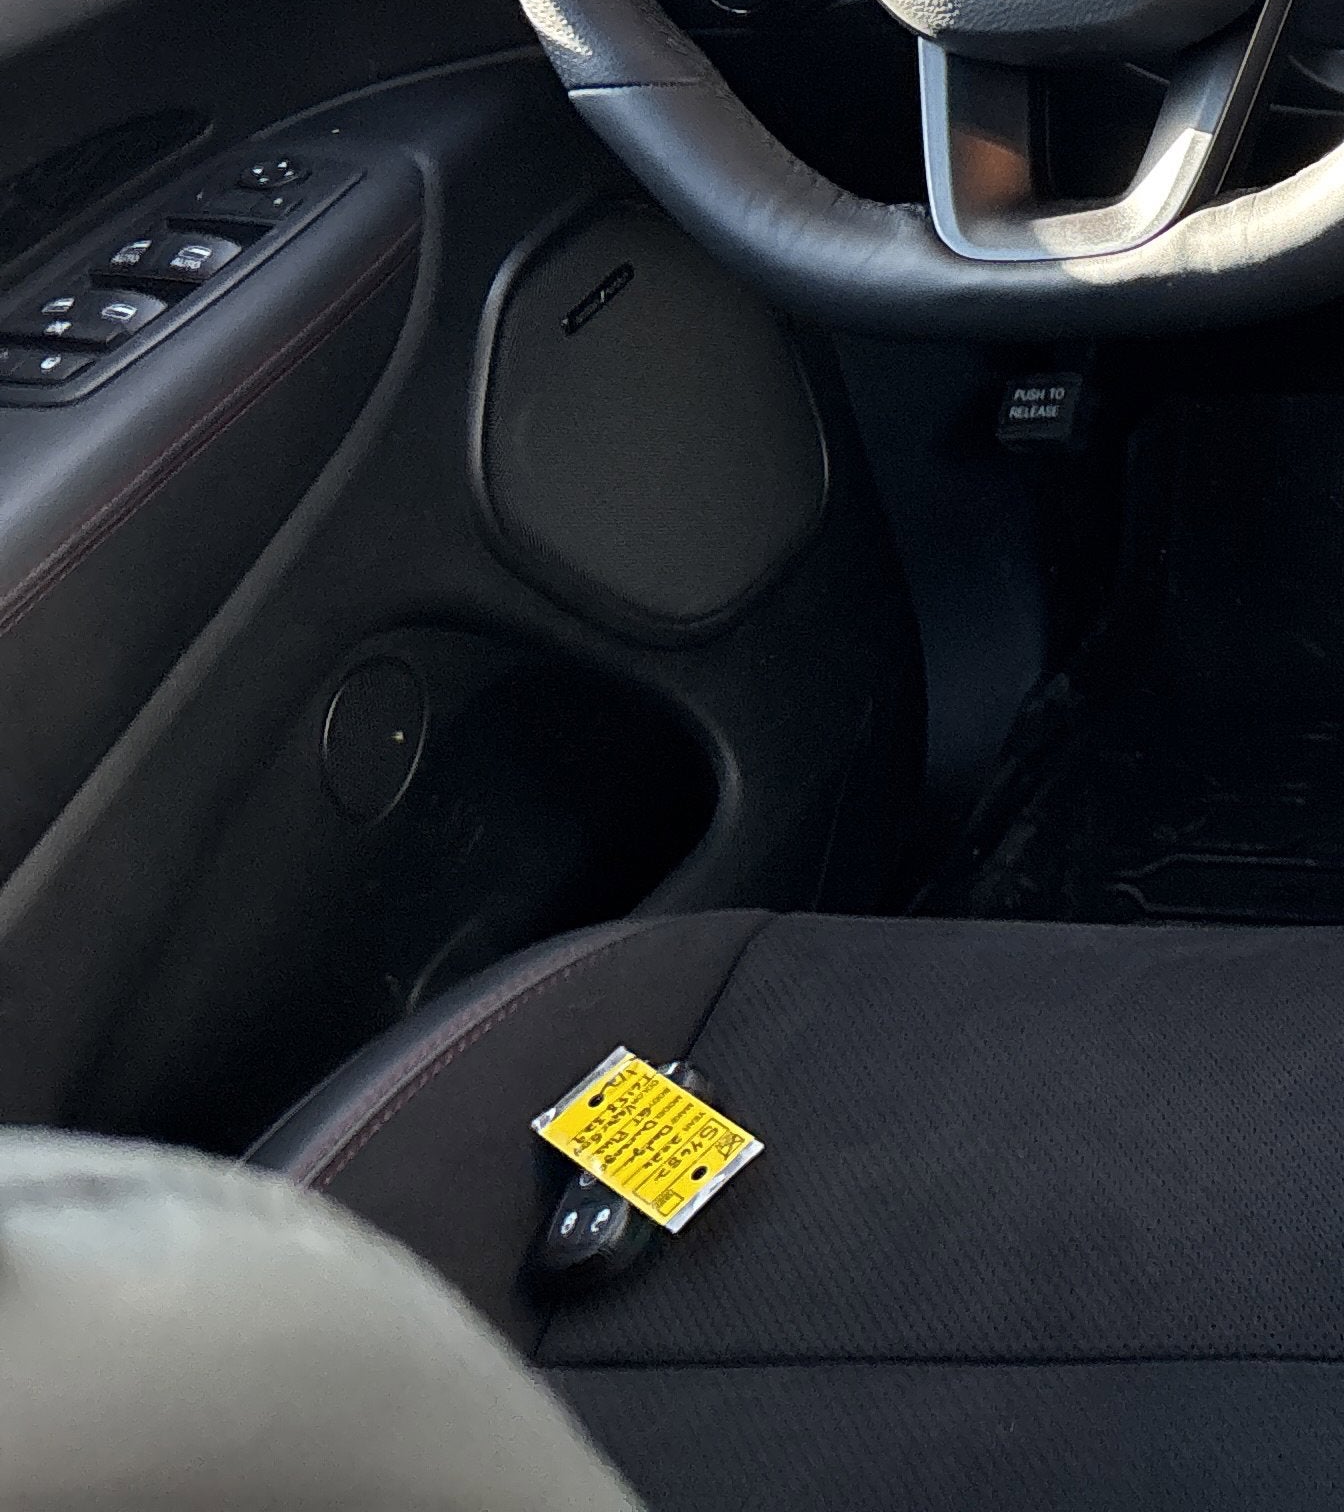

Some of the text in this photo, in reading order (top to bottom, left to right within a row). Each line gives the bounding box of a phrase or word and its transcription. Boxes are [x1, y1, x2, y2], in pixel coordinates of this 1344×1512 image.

[1013, 387, 1066, 401] PUSH TO
[1008, 404, 1058, 419] RELEASE
